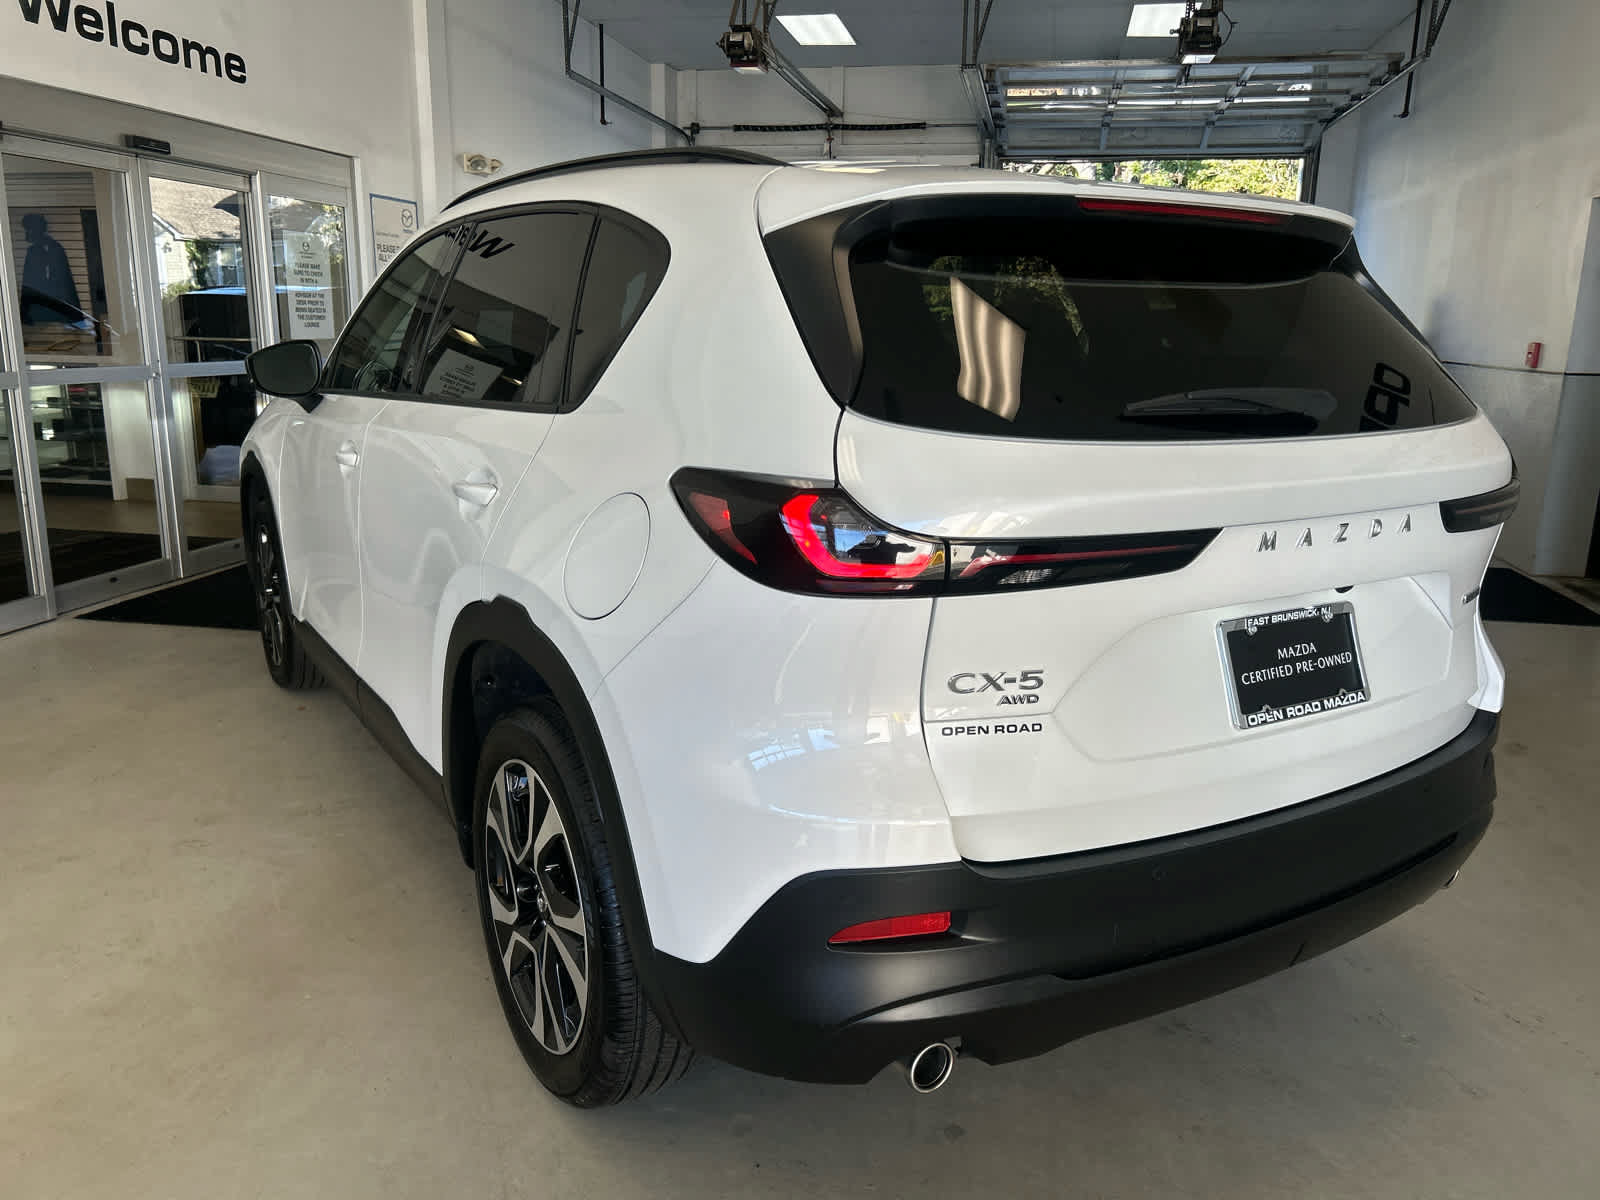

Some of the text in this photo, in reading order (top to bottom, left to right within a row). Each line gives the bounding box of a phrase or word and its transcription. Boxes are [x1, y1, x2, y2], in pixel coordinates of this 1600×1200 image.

[18, 0, 247, 84] Welcome
[1257, 513, 1412, 552] MAZDA
[1277, 643, 1317, 660] MAZDA
[947, 670, 1044, 694] CX-5
[1241, 652, 1352, 685] CERTIFIED PRE-OWNED
[997, 694, 1040, 706] AWD
[1248, 691, 1365, 726] OPEN ROAD MAZDA
[941, 723, 1042, 736] OPEN ROAD
